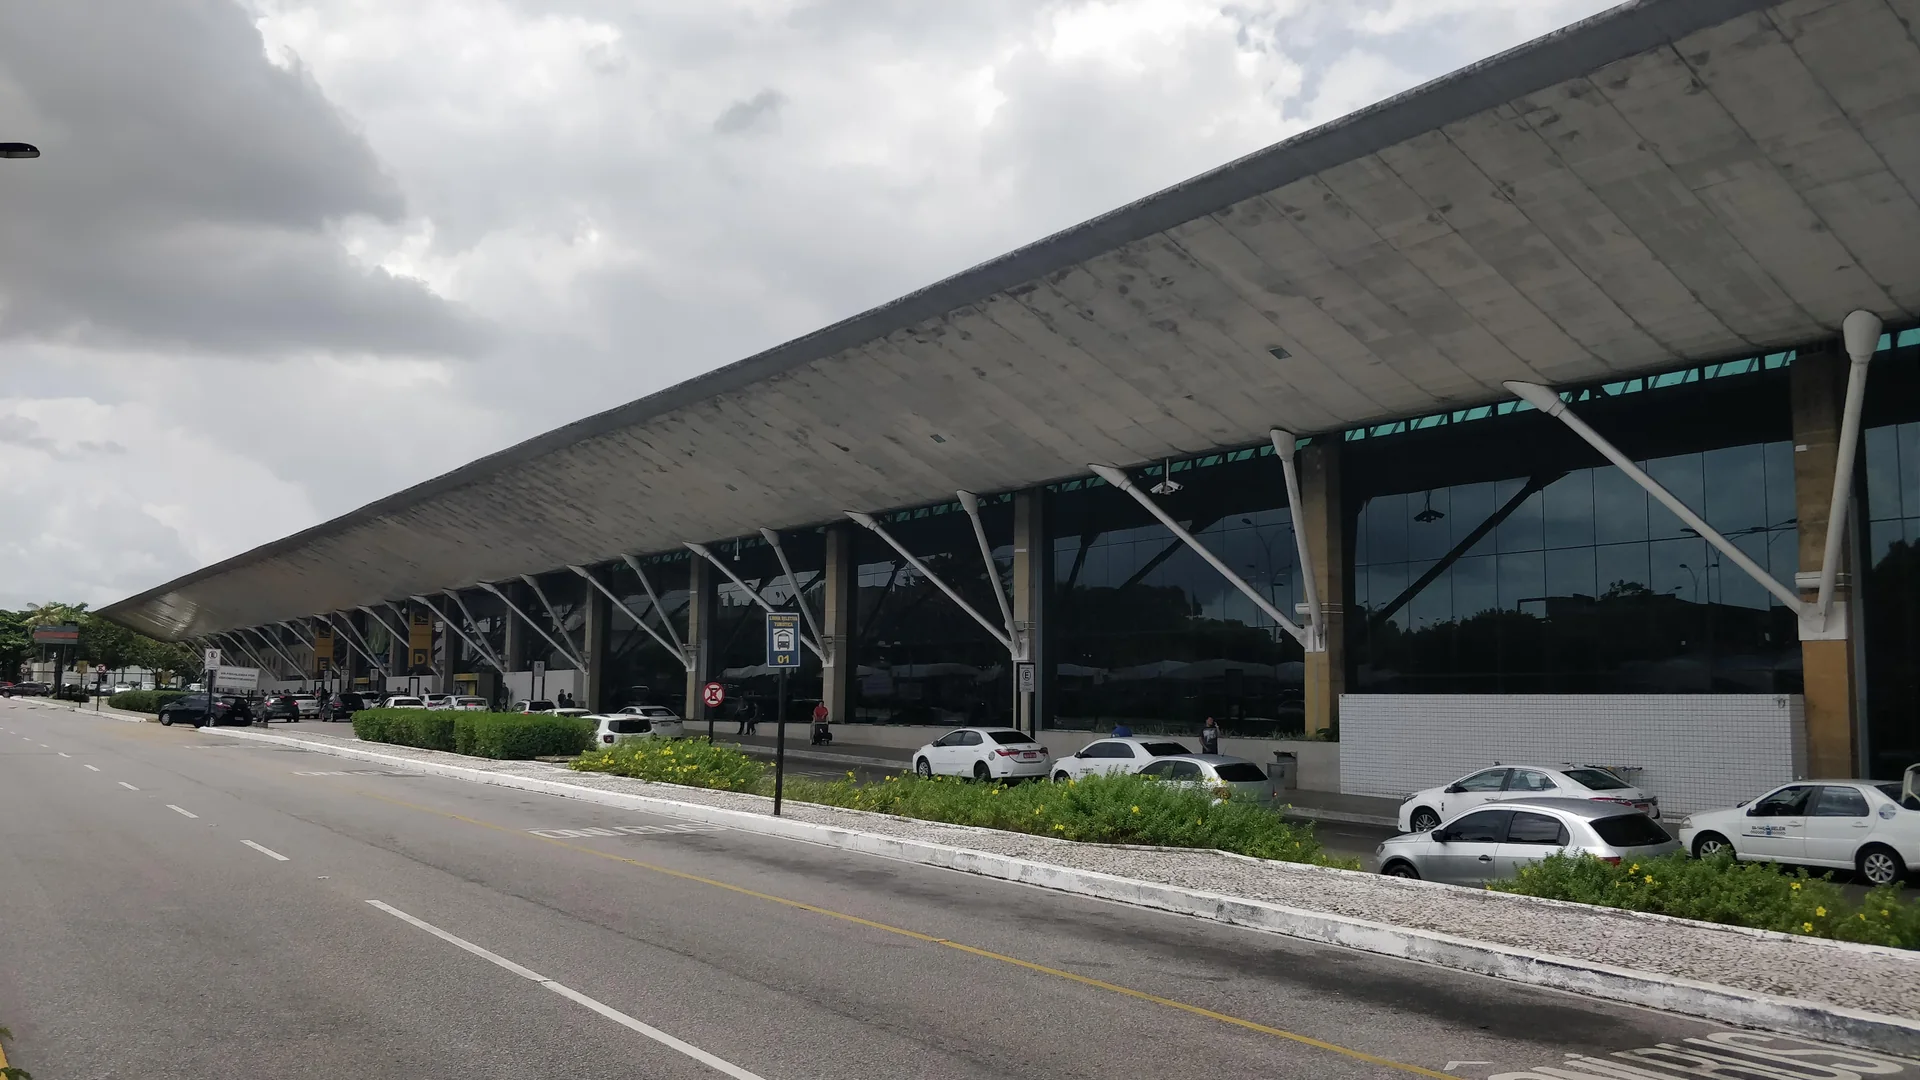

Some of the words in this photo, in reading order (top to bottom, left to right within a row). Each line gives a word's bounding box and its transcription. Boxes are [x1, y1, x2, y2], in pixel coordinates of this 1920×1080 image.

[414, 653, 426, 665] D
[777, 655, 790, 664] 01
[1443, 1032, 1904, 1080] IBUS
